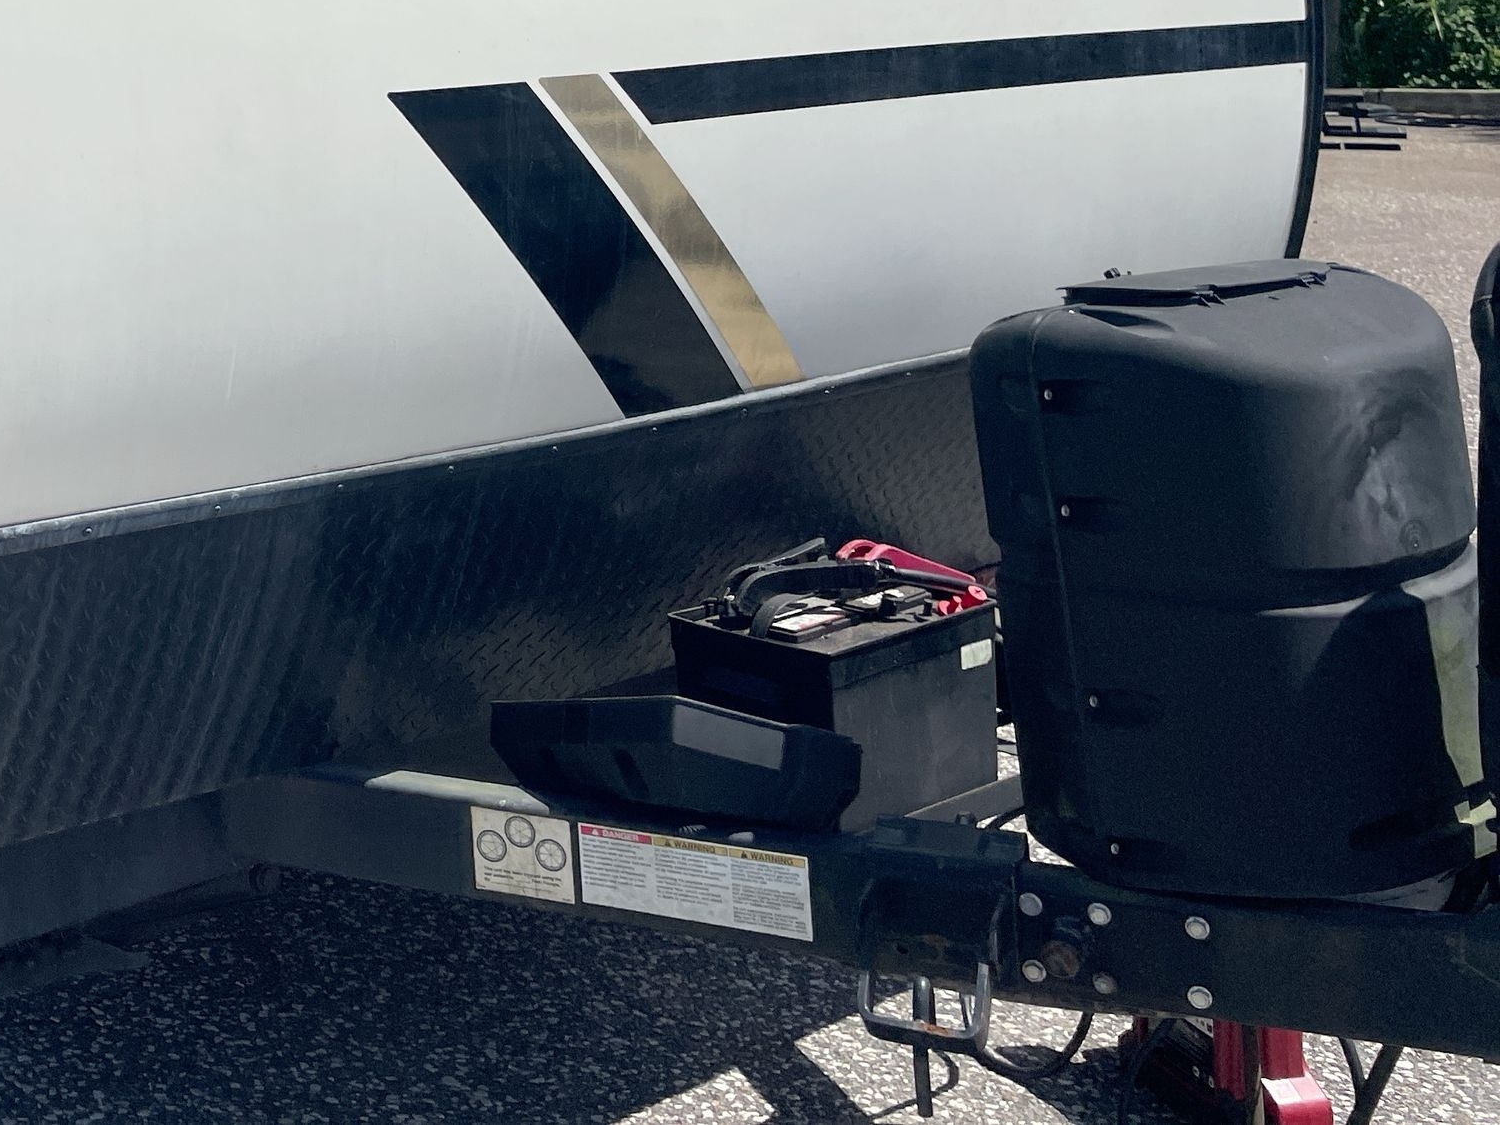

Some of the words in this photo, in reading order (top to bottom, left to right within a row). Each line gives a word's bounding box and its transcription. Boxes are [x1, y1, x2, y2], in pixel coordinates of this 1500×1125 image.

[602, 829, 639, 842] DANGER
[674, 840, 716, 854] WARNING
[749, 851, 794, 866] WARNING
